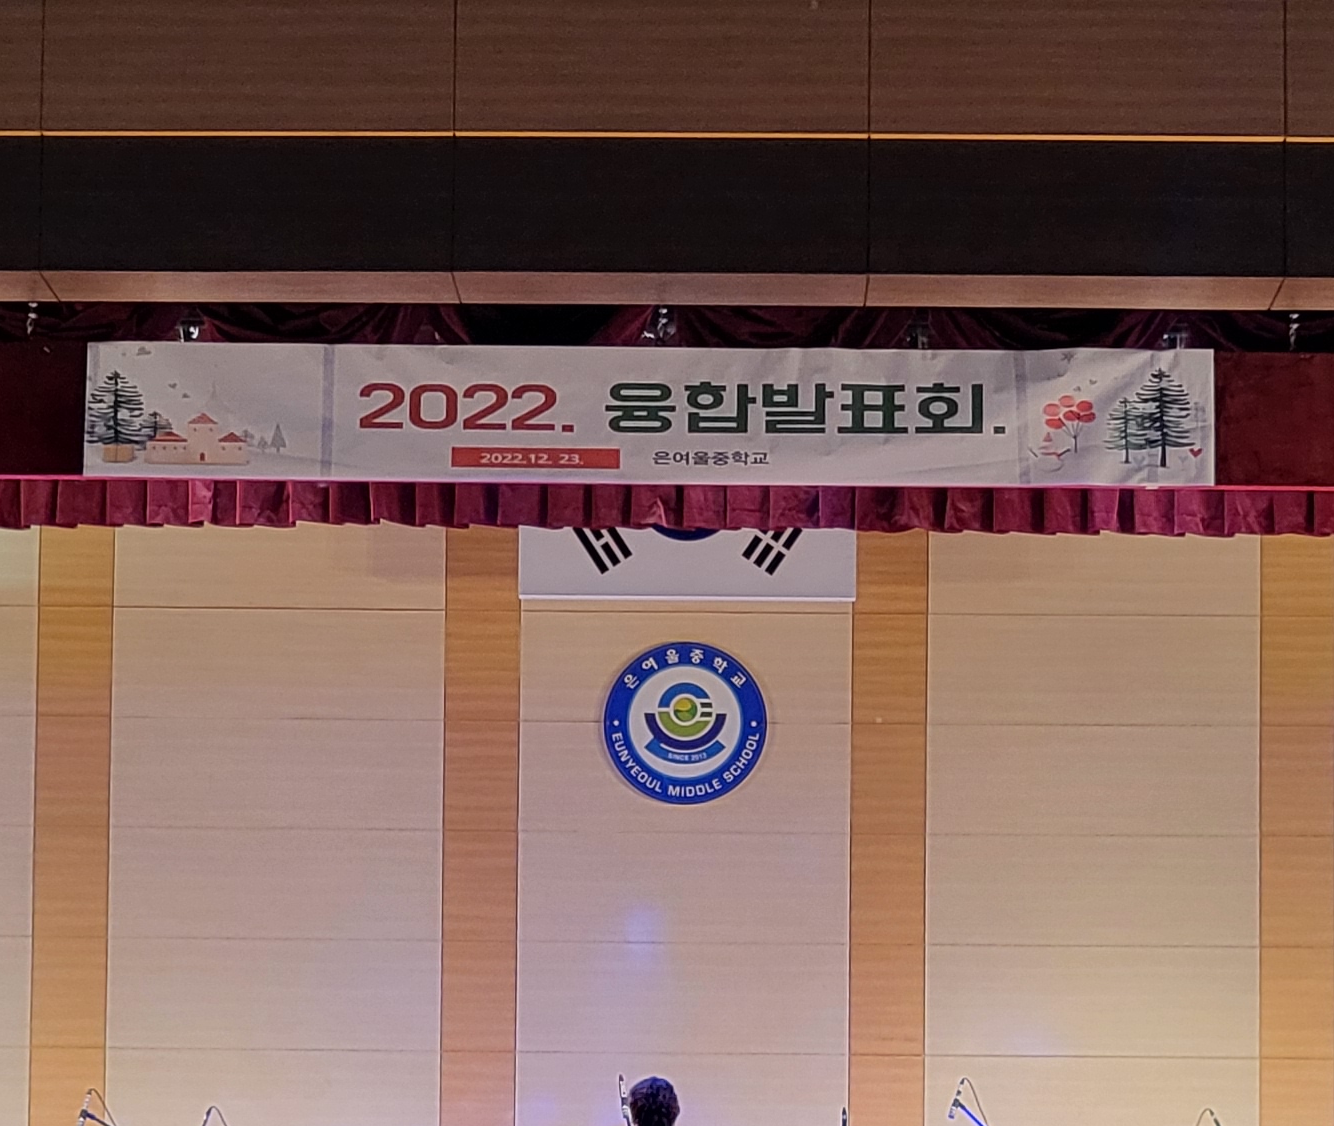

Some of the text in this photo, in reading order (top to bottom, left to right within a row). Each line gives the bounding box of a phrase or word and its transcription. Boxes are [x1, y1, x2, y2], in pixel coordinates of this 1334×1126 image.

[358, 380, 1007, 435] 2022. 융합발표회.
[651, 450, 770, 467] 은여울중학교
[623, 648, 747, 689] 은여울중학교
[611, 731, 760, 798] EUNYEOUL MIDDLE SCHOOL
